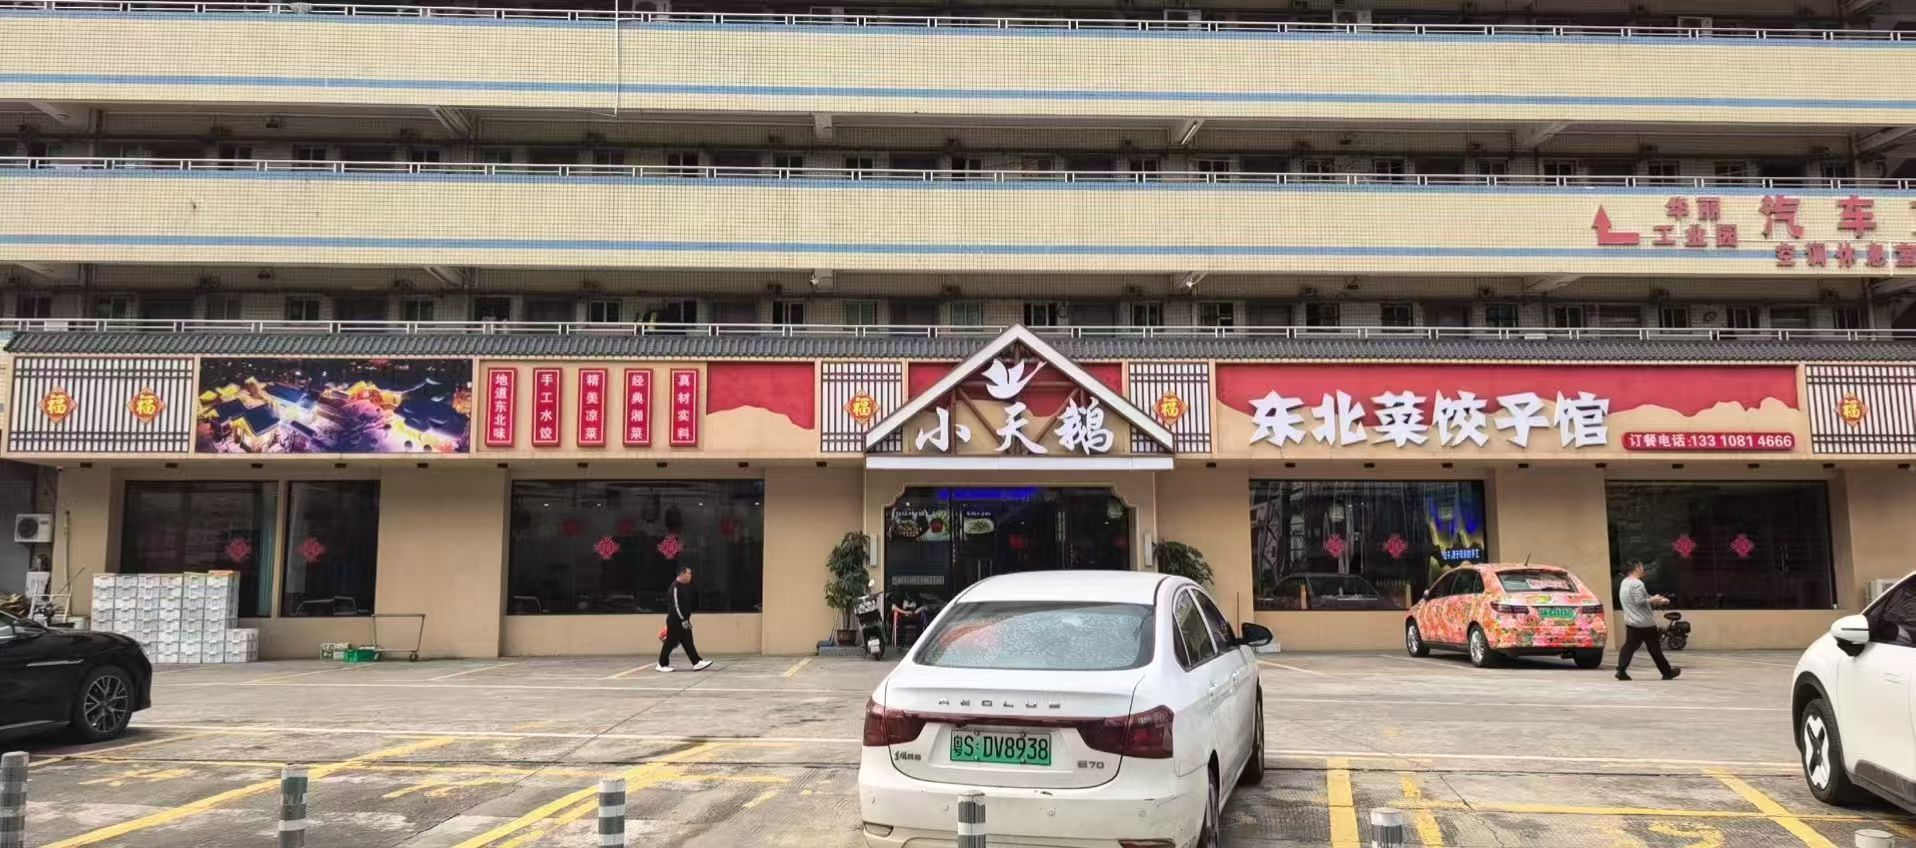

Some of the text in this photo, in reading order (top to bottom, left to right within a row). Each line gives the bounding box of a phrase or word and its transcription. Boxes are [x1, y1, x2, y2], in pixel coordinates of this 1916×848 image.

[1652, 223, 1738, 248] 工业园
[1664, 196, 1721, 221] 华丽
[492, 373, 509, 440] 地道东北味
[539, 373, 554, 440] 手工水饺
[585, 373, 600, 440] 精美凉菜
[630, 374, 644, 440] 经典湘菜
[676, 374, 691, 440] 真材实料
[915, 396, 1115, 455] 小天鹅
[1248, 389, 1611, 448] 东北菜饺子馆
[1720, 434, 1753, 448] 1081
[1757, 434, 1793, 448] 4666
